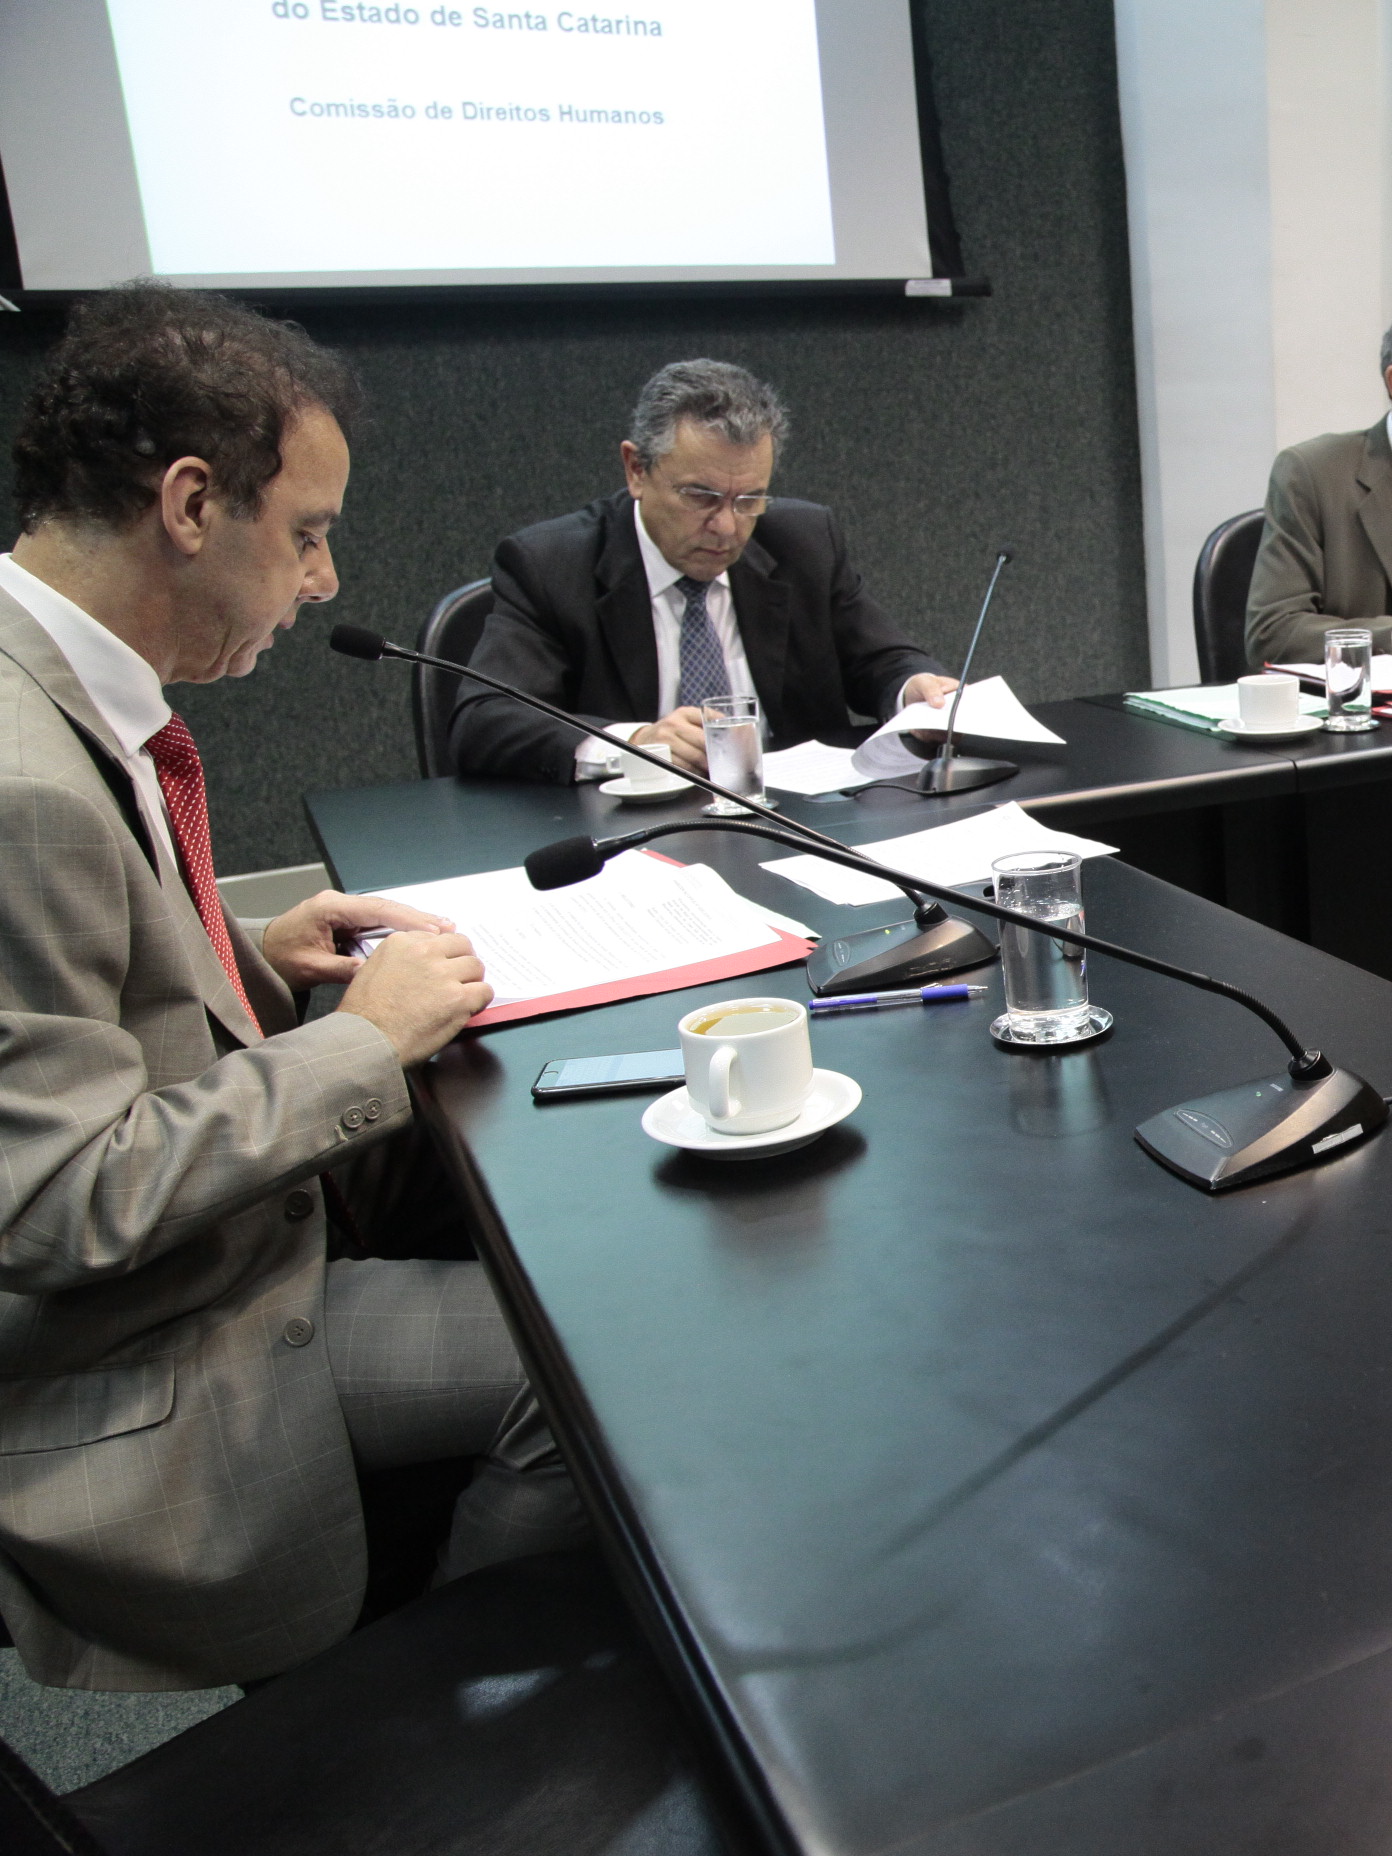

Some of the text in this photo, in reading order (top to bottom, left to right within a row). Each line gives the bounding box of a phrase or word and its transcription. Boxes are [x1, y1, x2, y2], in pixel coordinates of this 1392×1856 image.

[272, 0, 663, 37] do Estado de Santa Catarina
[289, 97, 665, 125] Comissão de Direitos Humanos
